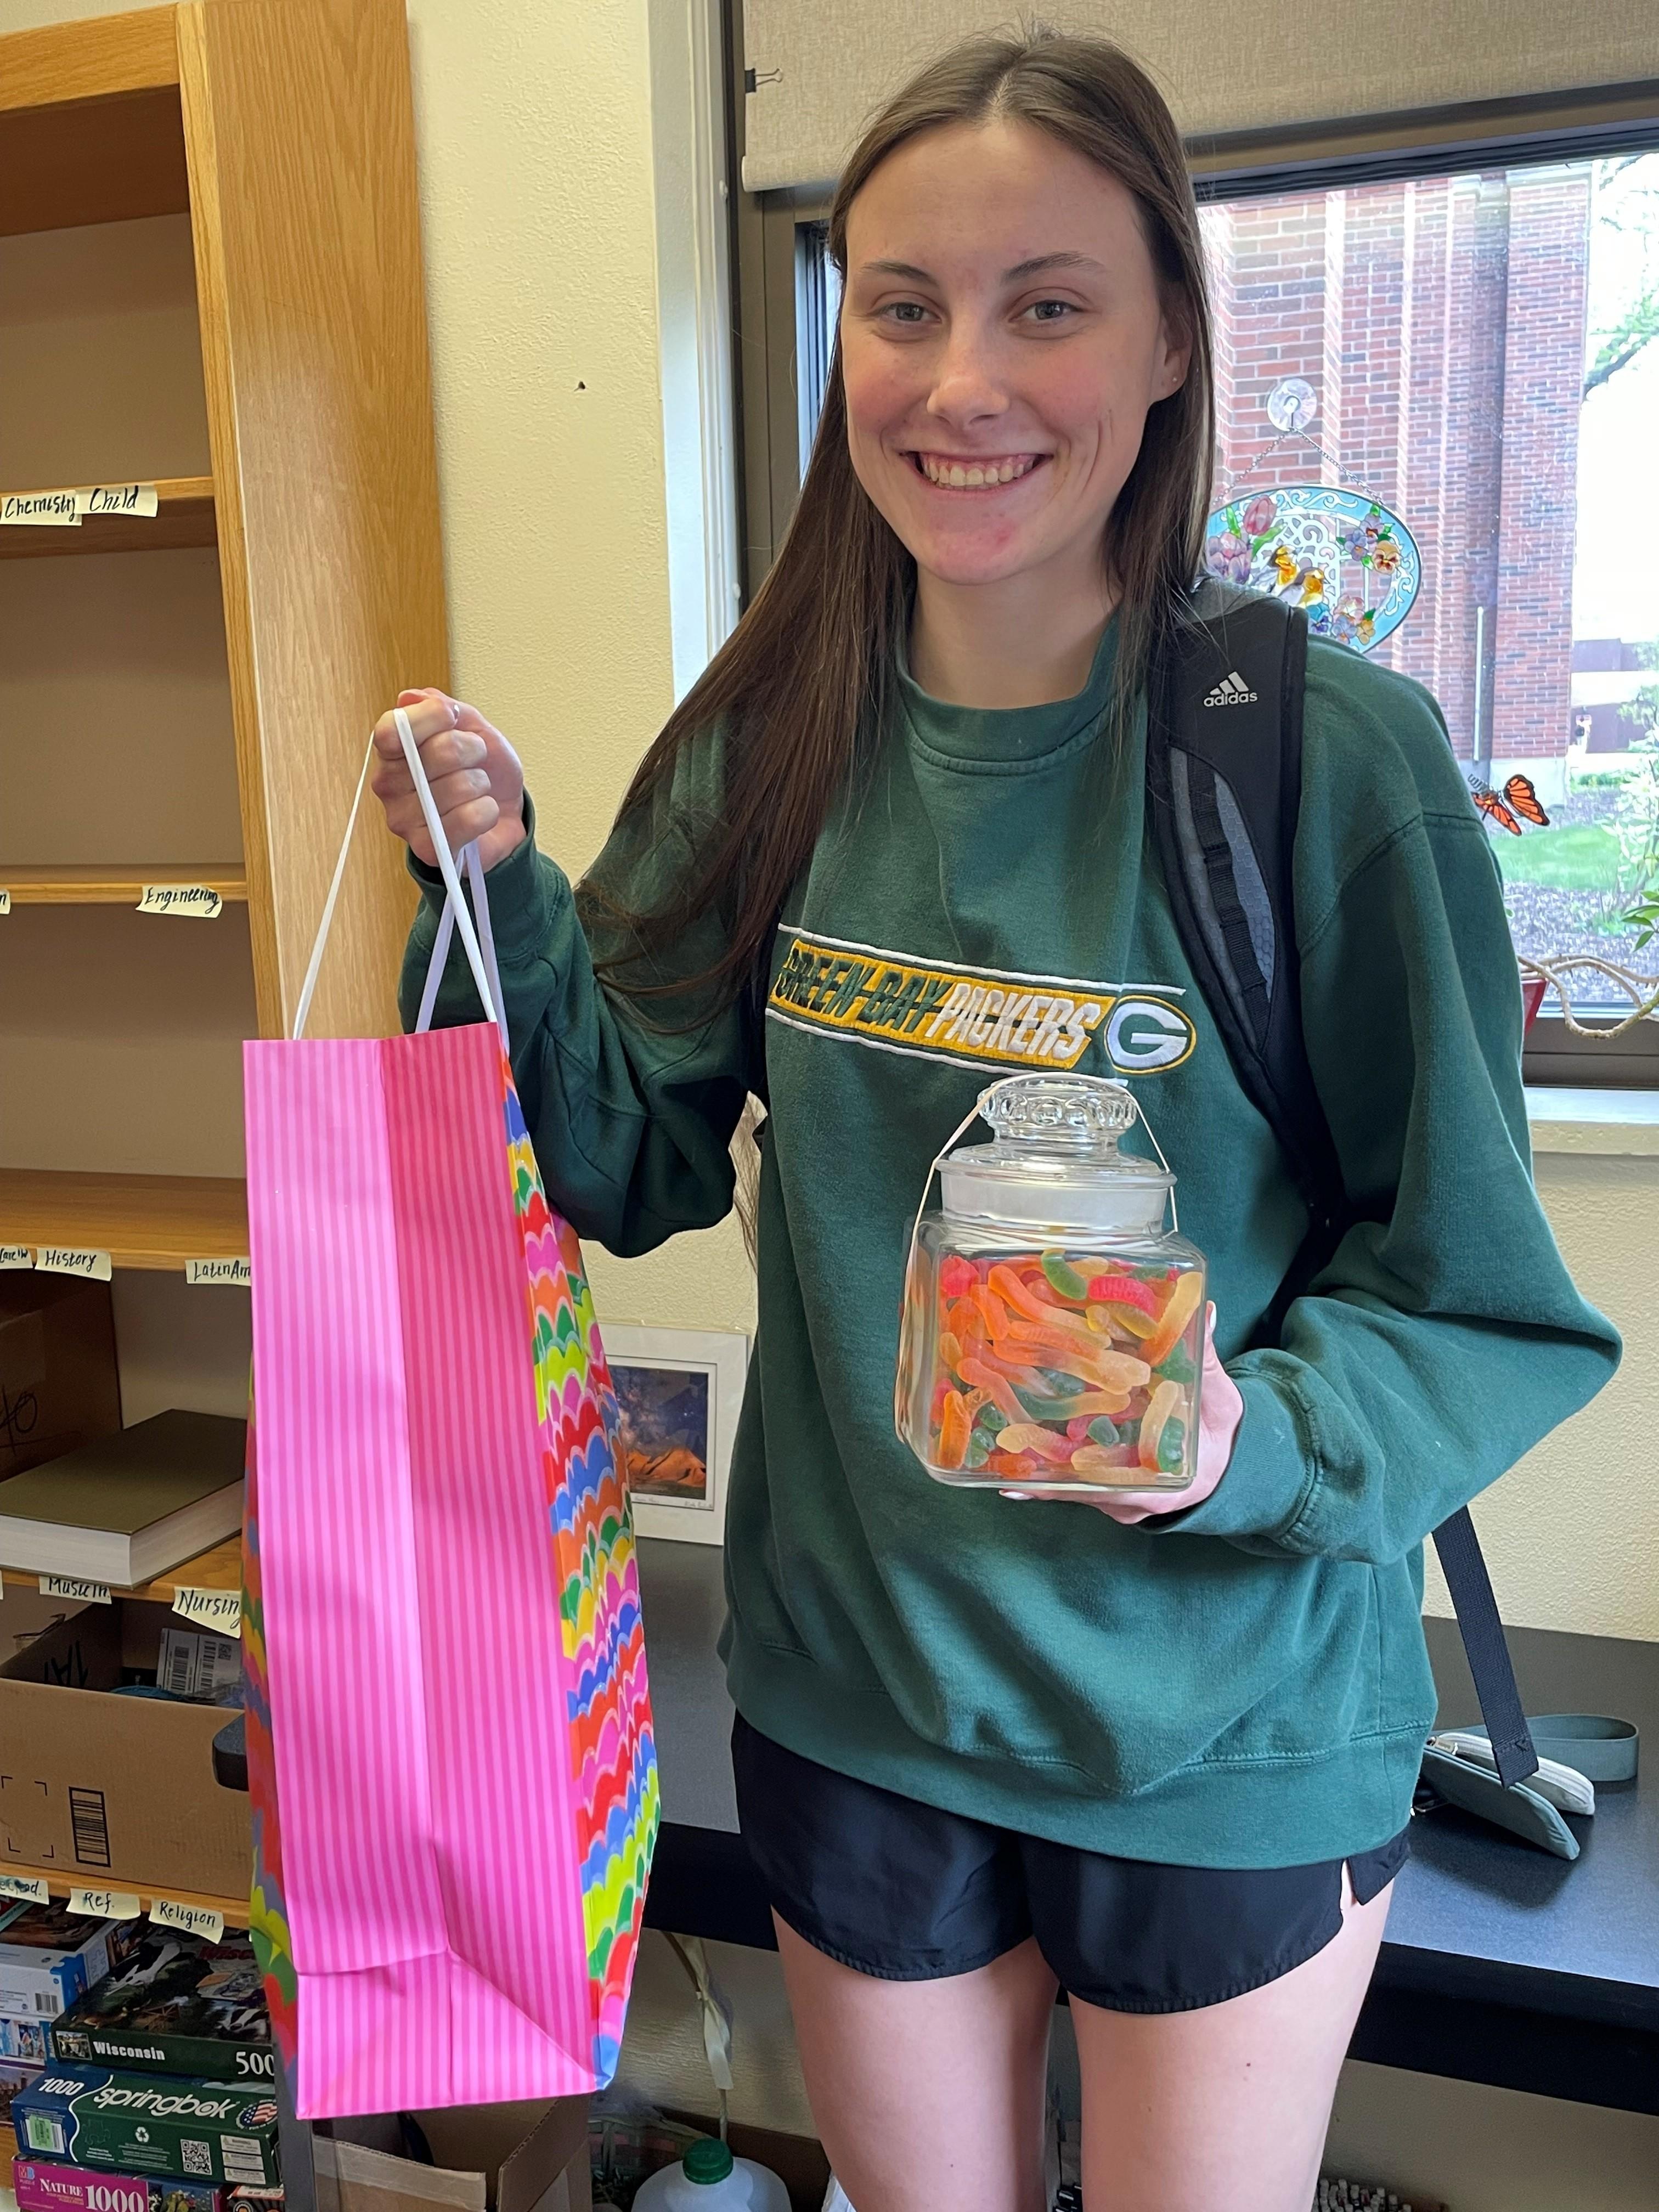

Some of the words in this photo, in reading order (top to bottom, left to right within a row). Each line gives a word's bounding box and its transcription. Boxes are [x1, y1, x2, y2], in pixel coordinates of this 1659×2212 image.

[5, 494, 75, 522] Chemistry
[90, 485, 139, 511] Child
[1204, 691, 1257, 707] adidas
[145, 887, 219, 914] Engineering
[775, 948, 878, 1017] GREEN
[857, 970, 952, 1031] BAY
[924, 982, 1101, 1060] PACKERS
[1107, 1002, 1187, 1069] G
[45, 1250, 97, 1272] History
[84, 1892, 115, 1914] Ref.
[160, 1901, 216, 1929] Religion
[93, 2041, 166, 2061] Wisconsin
[38, 2078, 85, 2096] 1000
[86, 2185, 145, 2212] 1000
